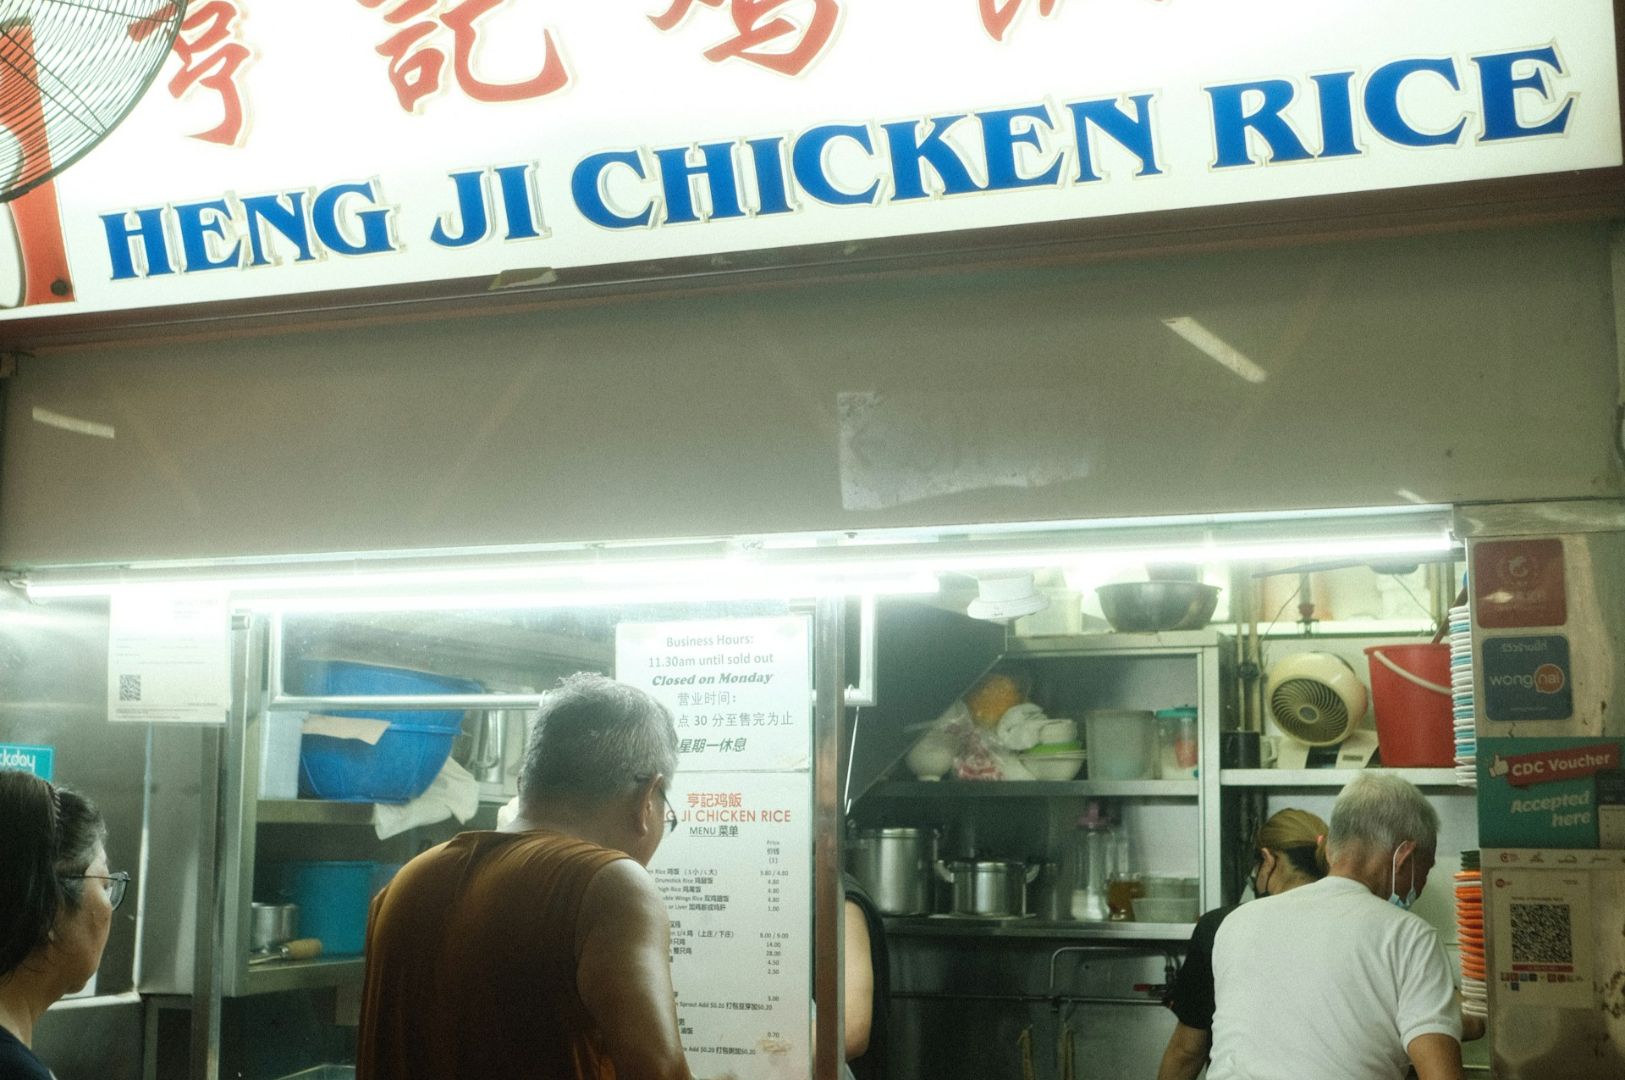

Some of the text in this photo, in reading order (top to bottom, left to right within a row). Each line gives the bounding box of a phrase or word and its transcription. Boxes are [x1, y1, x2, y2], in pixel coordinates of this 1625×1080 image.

[101, 43, 1578, 281] HENG JI CHICKEN RICE
[666, 633, 754, 648] Business Hours:
[649, 652, 774, 668] 11.30am until sold out
[652, 671, 773, 687] Closed on Monday
[678, 713, 690, 728] 点
[694, 715, 708, 727] 30
[0, 749, 36, 773] kday
[1511, 753, 1611, 777] CDC Voucher
[1510, 790, 1590, 814] Accepted
[681, 810, 691, 823] JI
[695, 809, 756, 823] CHICKEN
[760, 809, 791, 823] RICE
[1551, 811, 1592, 828] here
[690, 825, 739, 837] MENU 菜单
